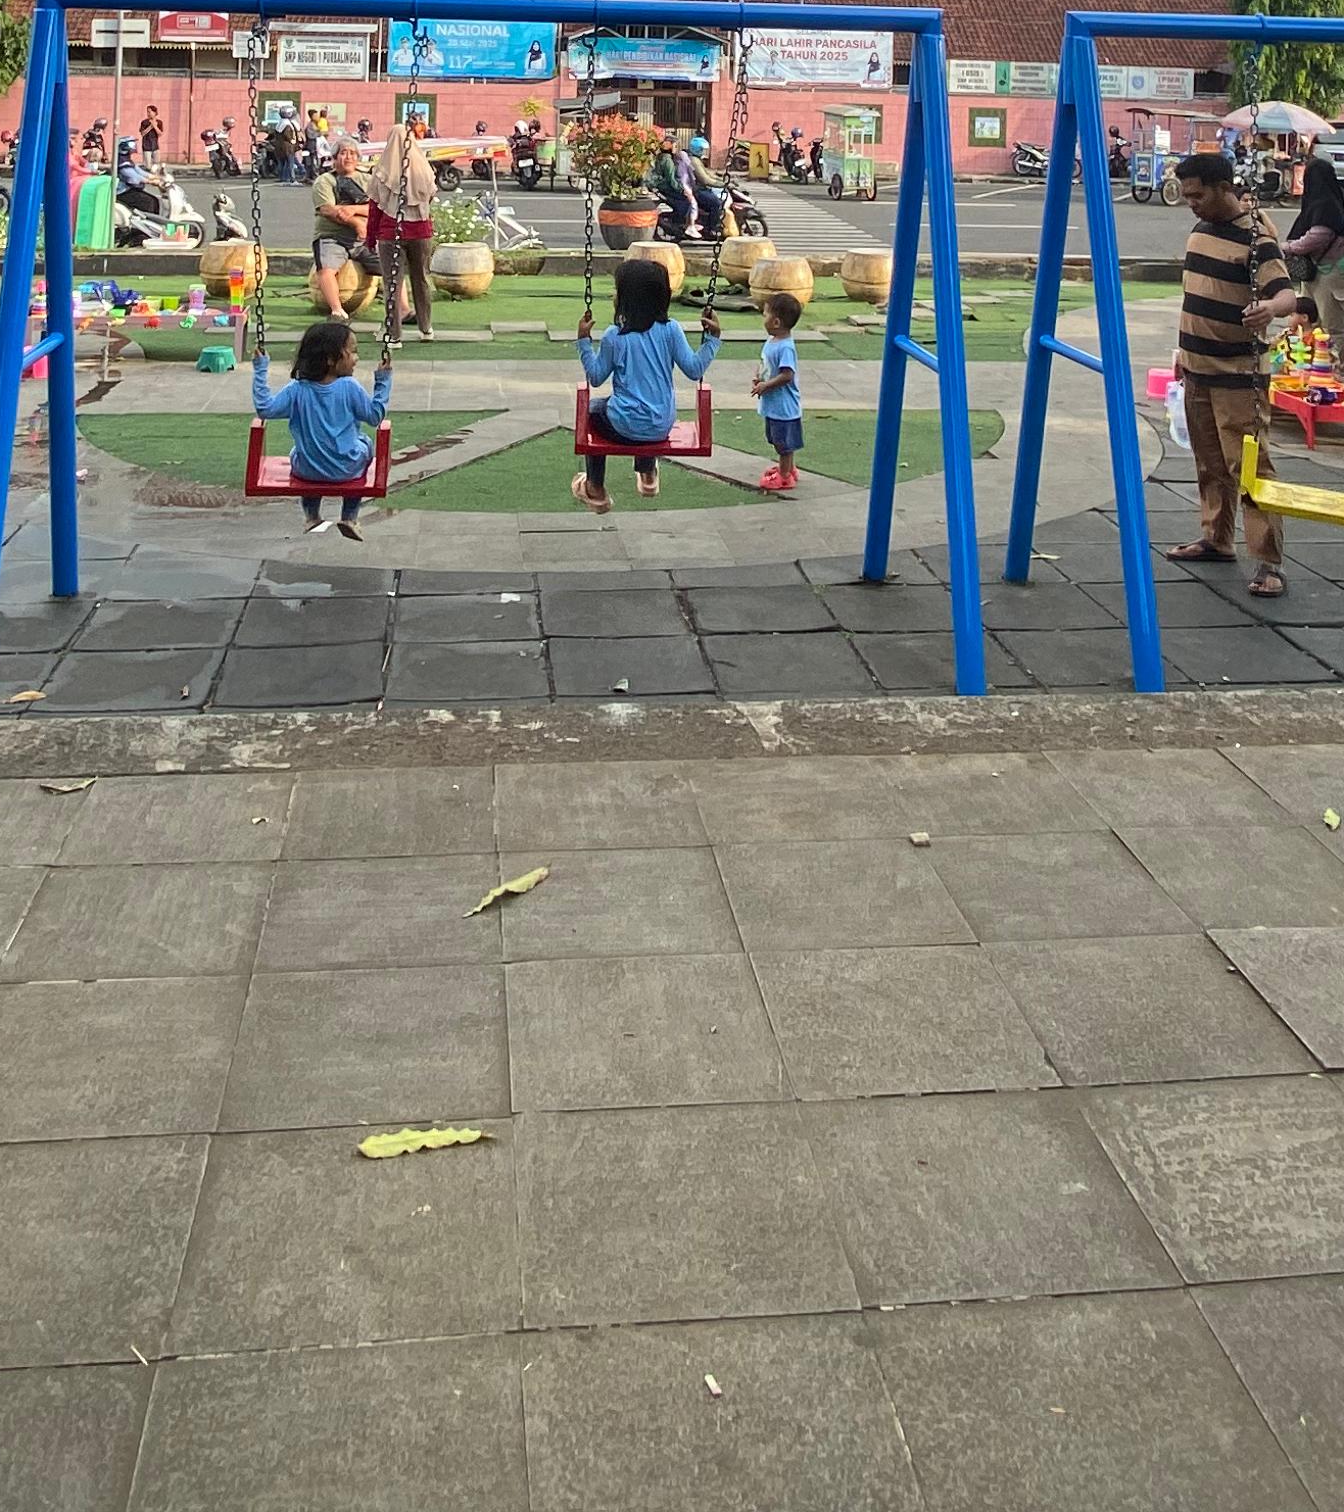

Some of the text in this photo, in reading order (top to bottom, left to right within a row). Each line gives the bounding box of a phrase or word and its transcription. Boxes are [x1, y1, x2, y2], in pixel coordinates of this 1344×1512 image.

[436, 23, 511, 38] NASIONAL
[779, 38, 812, 49] LAHIR
[815, 39, 877, 50] PANCASILA
[449, 55, 473, 69] 117
[780, 50, 849, 61] TAHUN 2025
